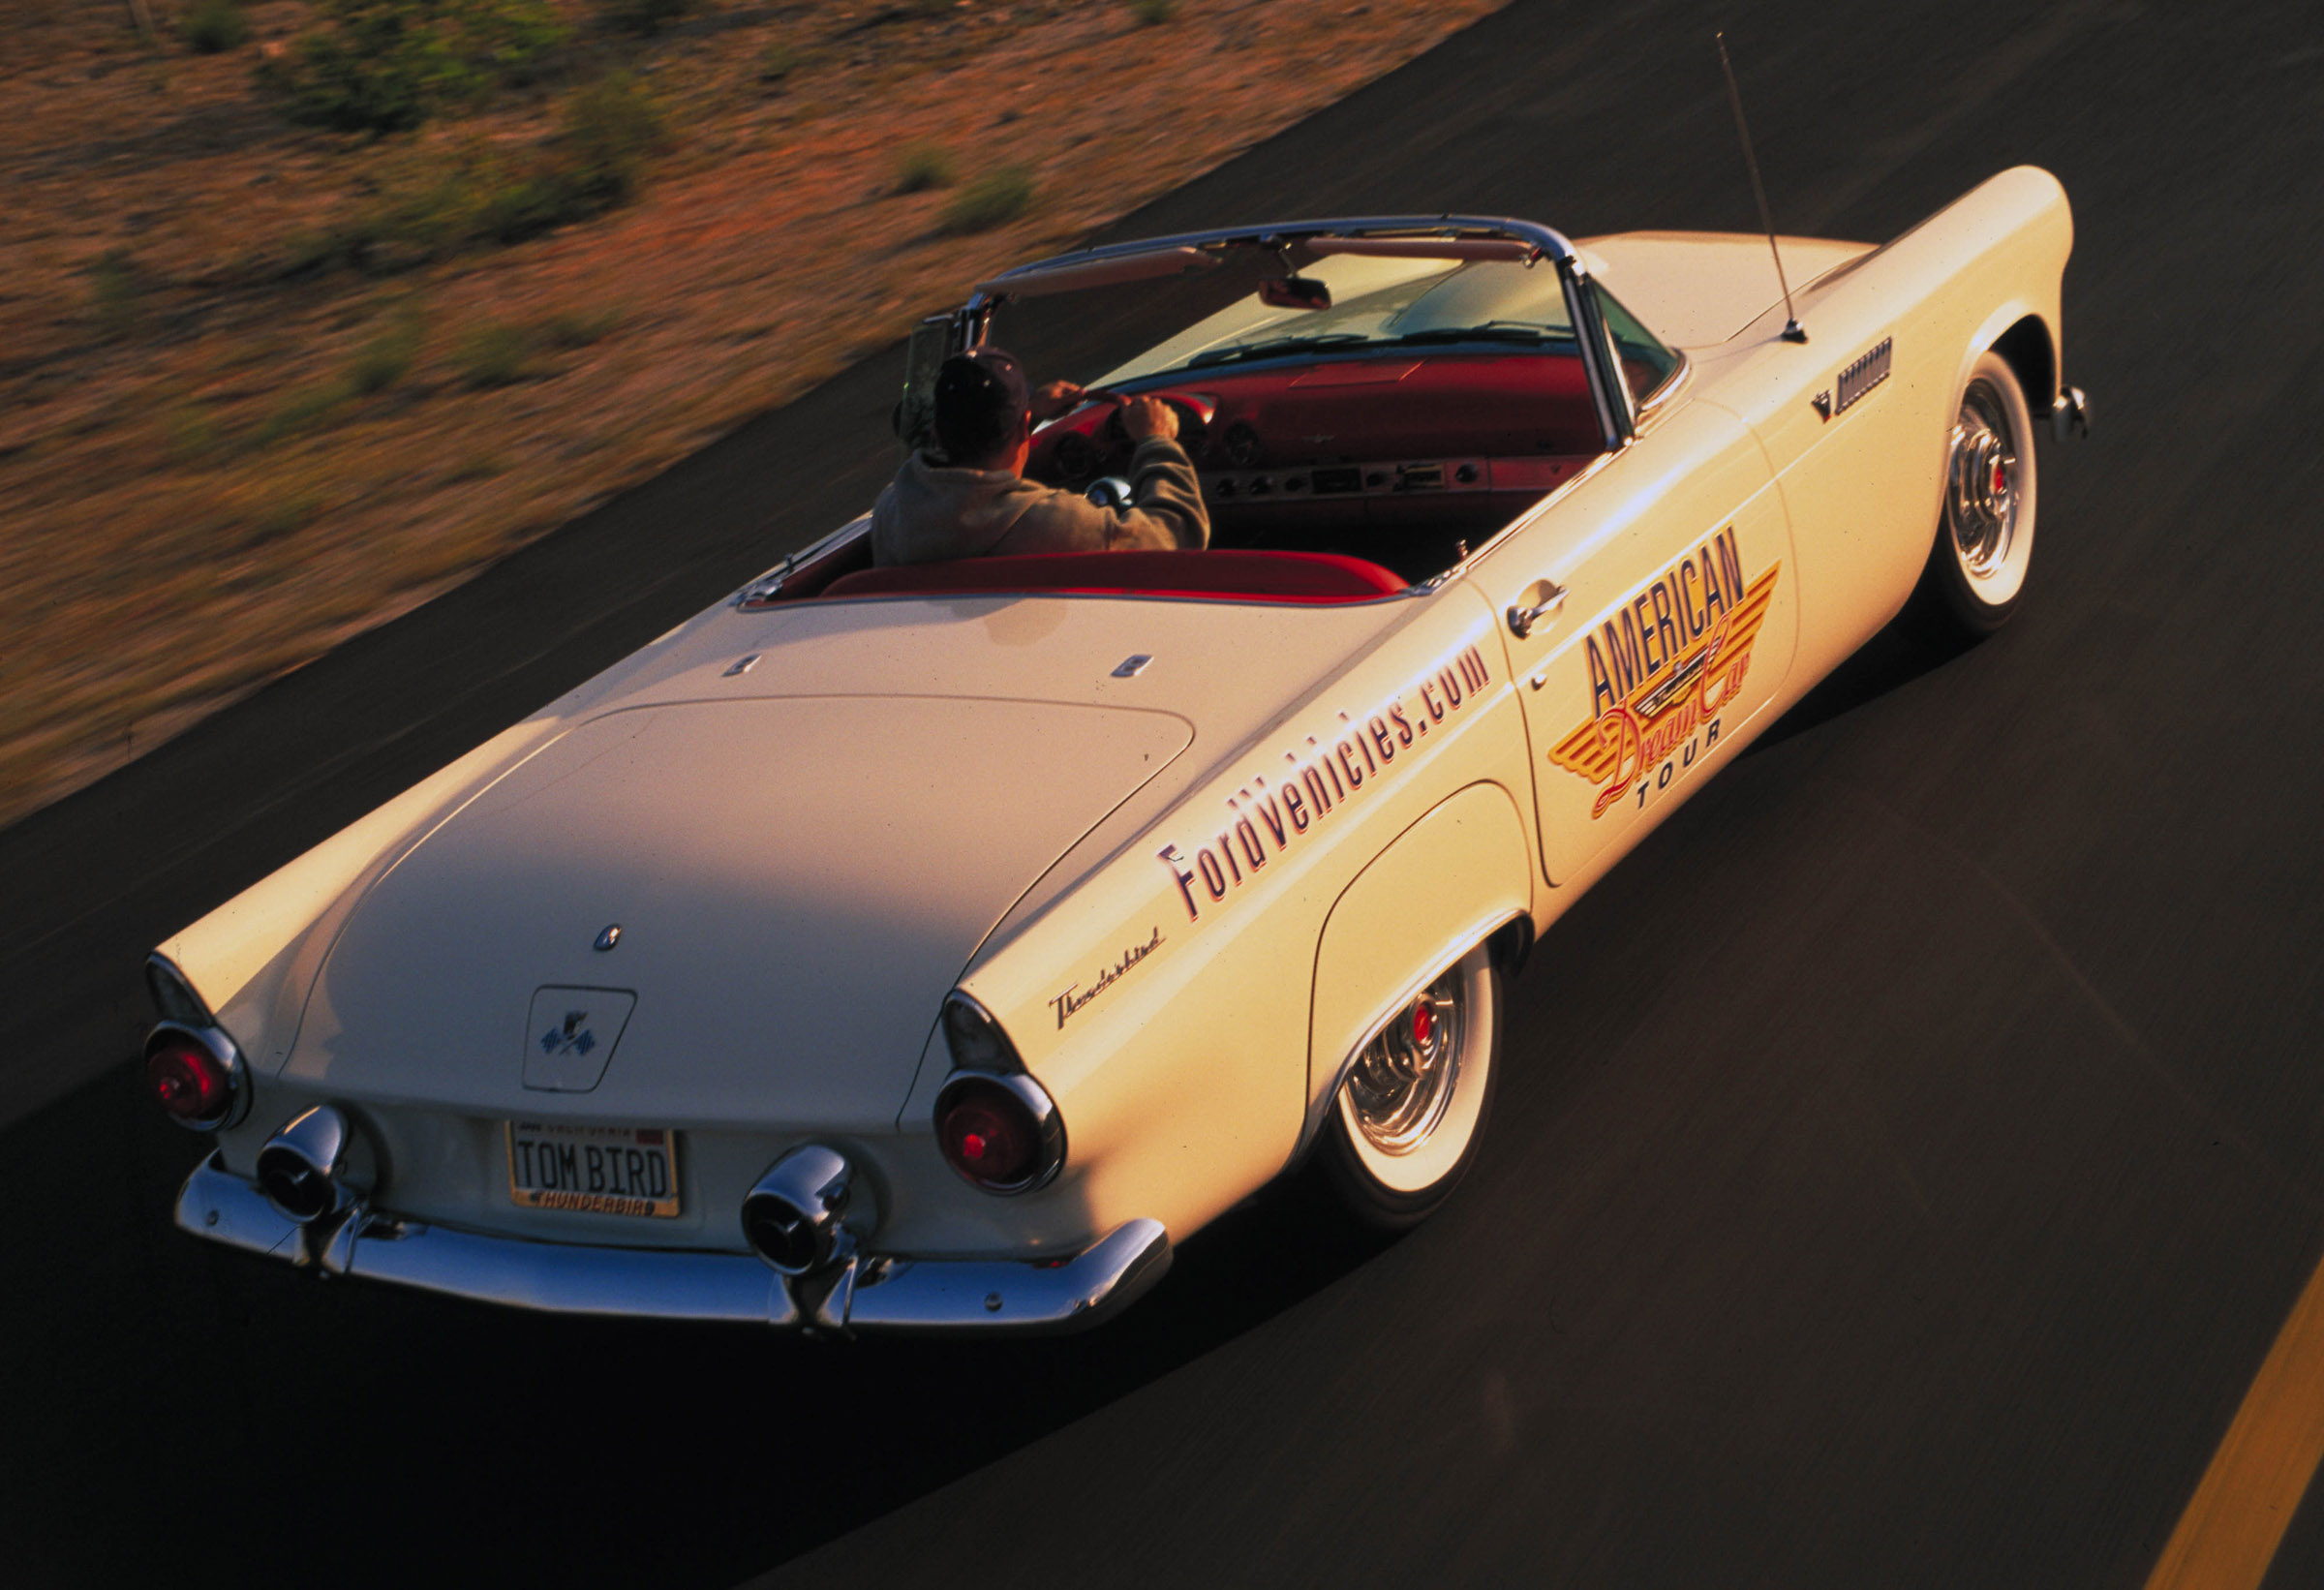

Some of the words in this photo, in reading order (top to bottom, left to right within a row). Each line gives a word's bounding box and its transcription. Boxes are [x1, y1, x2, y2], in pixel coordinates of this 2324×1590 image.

[1586, 525, 1744, 718] AMERICAN
[1593, 699, 1698, 814] Dream
[1701, 613, 1750, 719] Car
[1637, 718, 1721, 810] TOUR
[1049, 926, 1167, 1031] Thunderbird
[518, 1140, 580, 1191] TOM
[585, 1146, 666, 1198] BIRD
